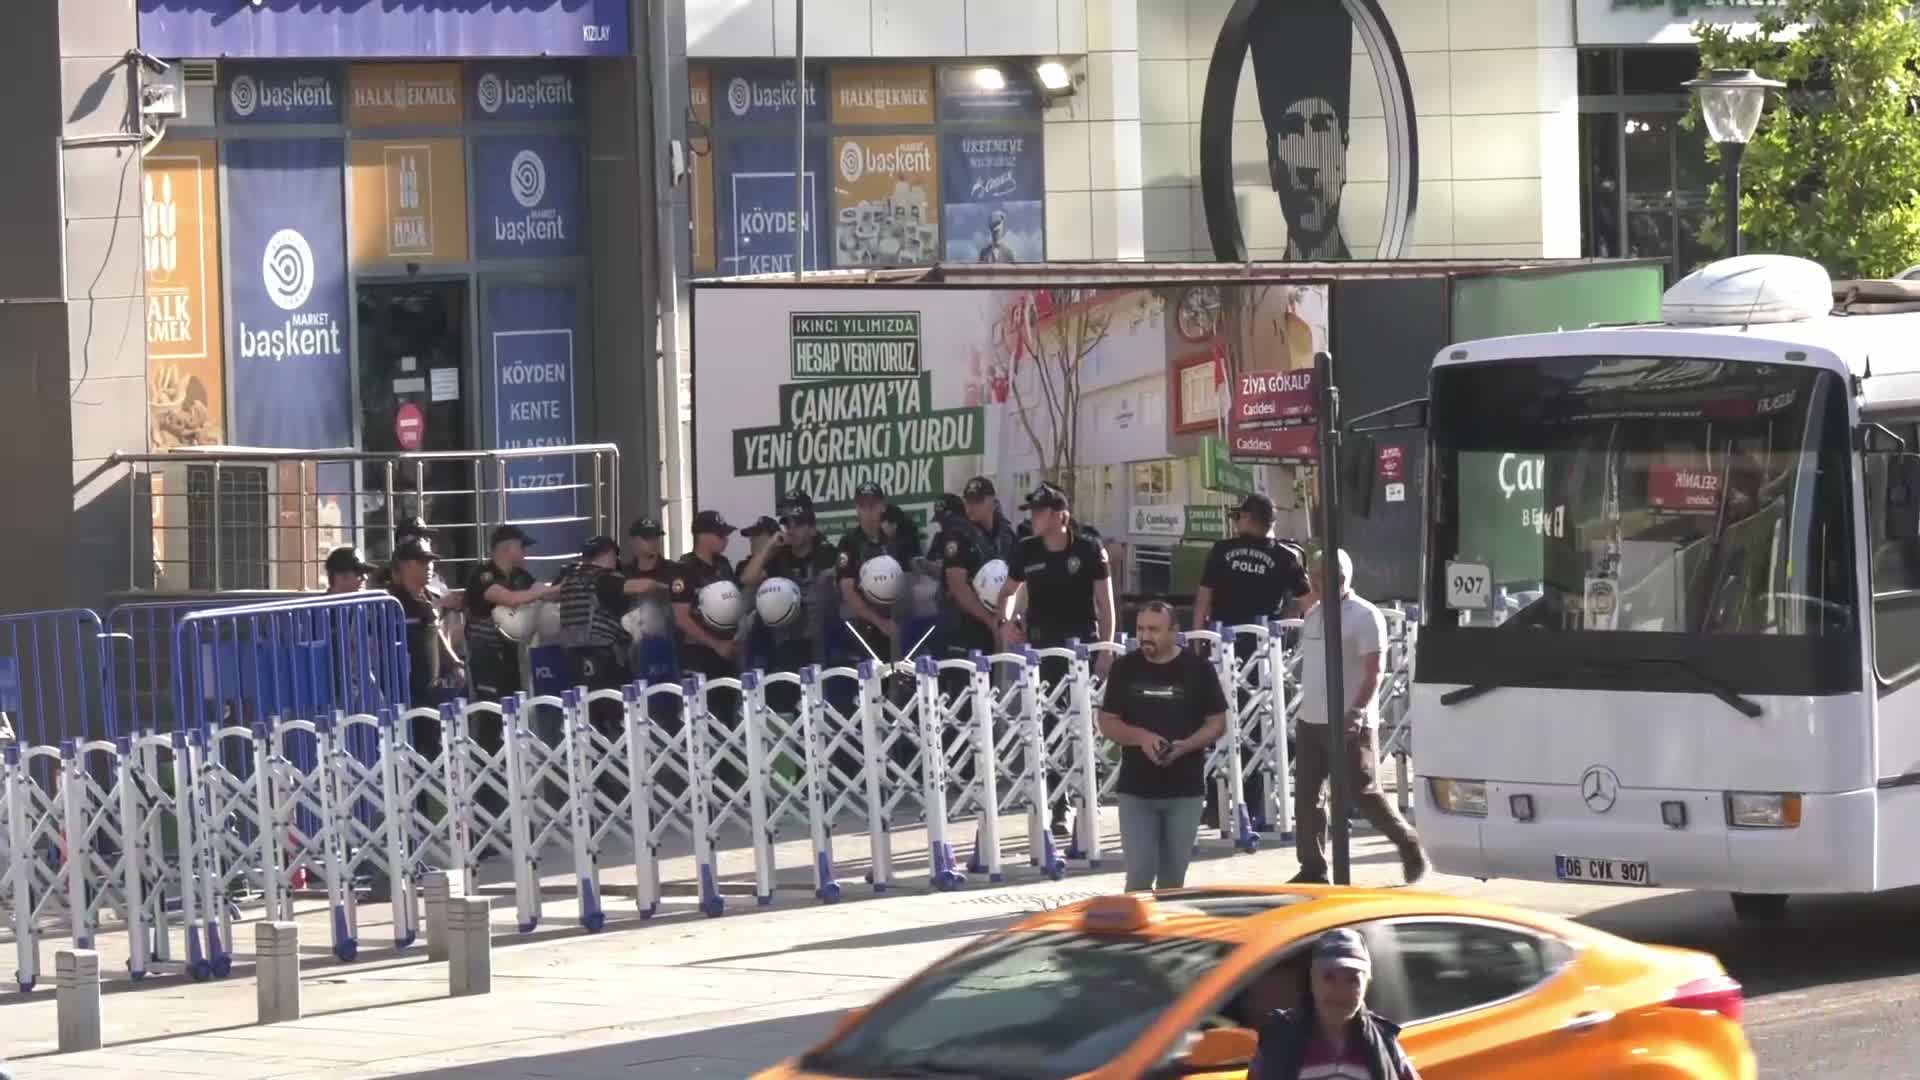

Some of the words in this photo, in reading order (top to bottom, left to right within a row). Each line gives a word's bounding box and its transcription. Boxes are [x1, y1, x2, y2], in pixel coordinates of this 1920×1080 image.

[259, 80, 333, 112] başkent
[505, 79, 574, 109] başkent
[866, 146, 932, 177] başkent
[495, 215, 566, 246] başkent
[749, 255, 794, 274] KENT
[147, 295, 190, 321] ALK
[292, 313, 329, 326] MARKET
[843, 318, 914, 333] YILIMIZDA
[240, 320, 341, 361] başkent
[797, 342, 839, 373] HESAP
[842, 341, 916, 372] VERİYORUZ
[502, 360, 566, 385] KÖYDEN
[1242, 375, 1267, 395] ZİYA
[510, 400, 561, 421] KENTE
[1243, 400, 1276, 415] Caddesi
[744, 432, 793, 470] YENİ
[798, 421, 892, 465] ÖĞRENCİ
[897, 413, 974, 455] YURDU
[1236, 438, 1272, 451] Caddesi
[1454, 575, 1485, 595] 907
[1566, 858, 1582, 877] 06
[1590, 860, 1614, 879] CVK
[1621, 863, 1645, 882] 907
